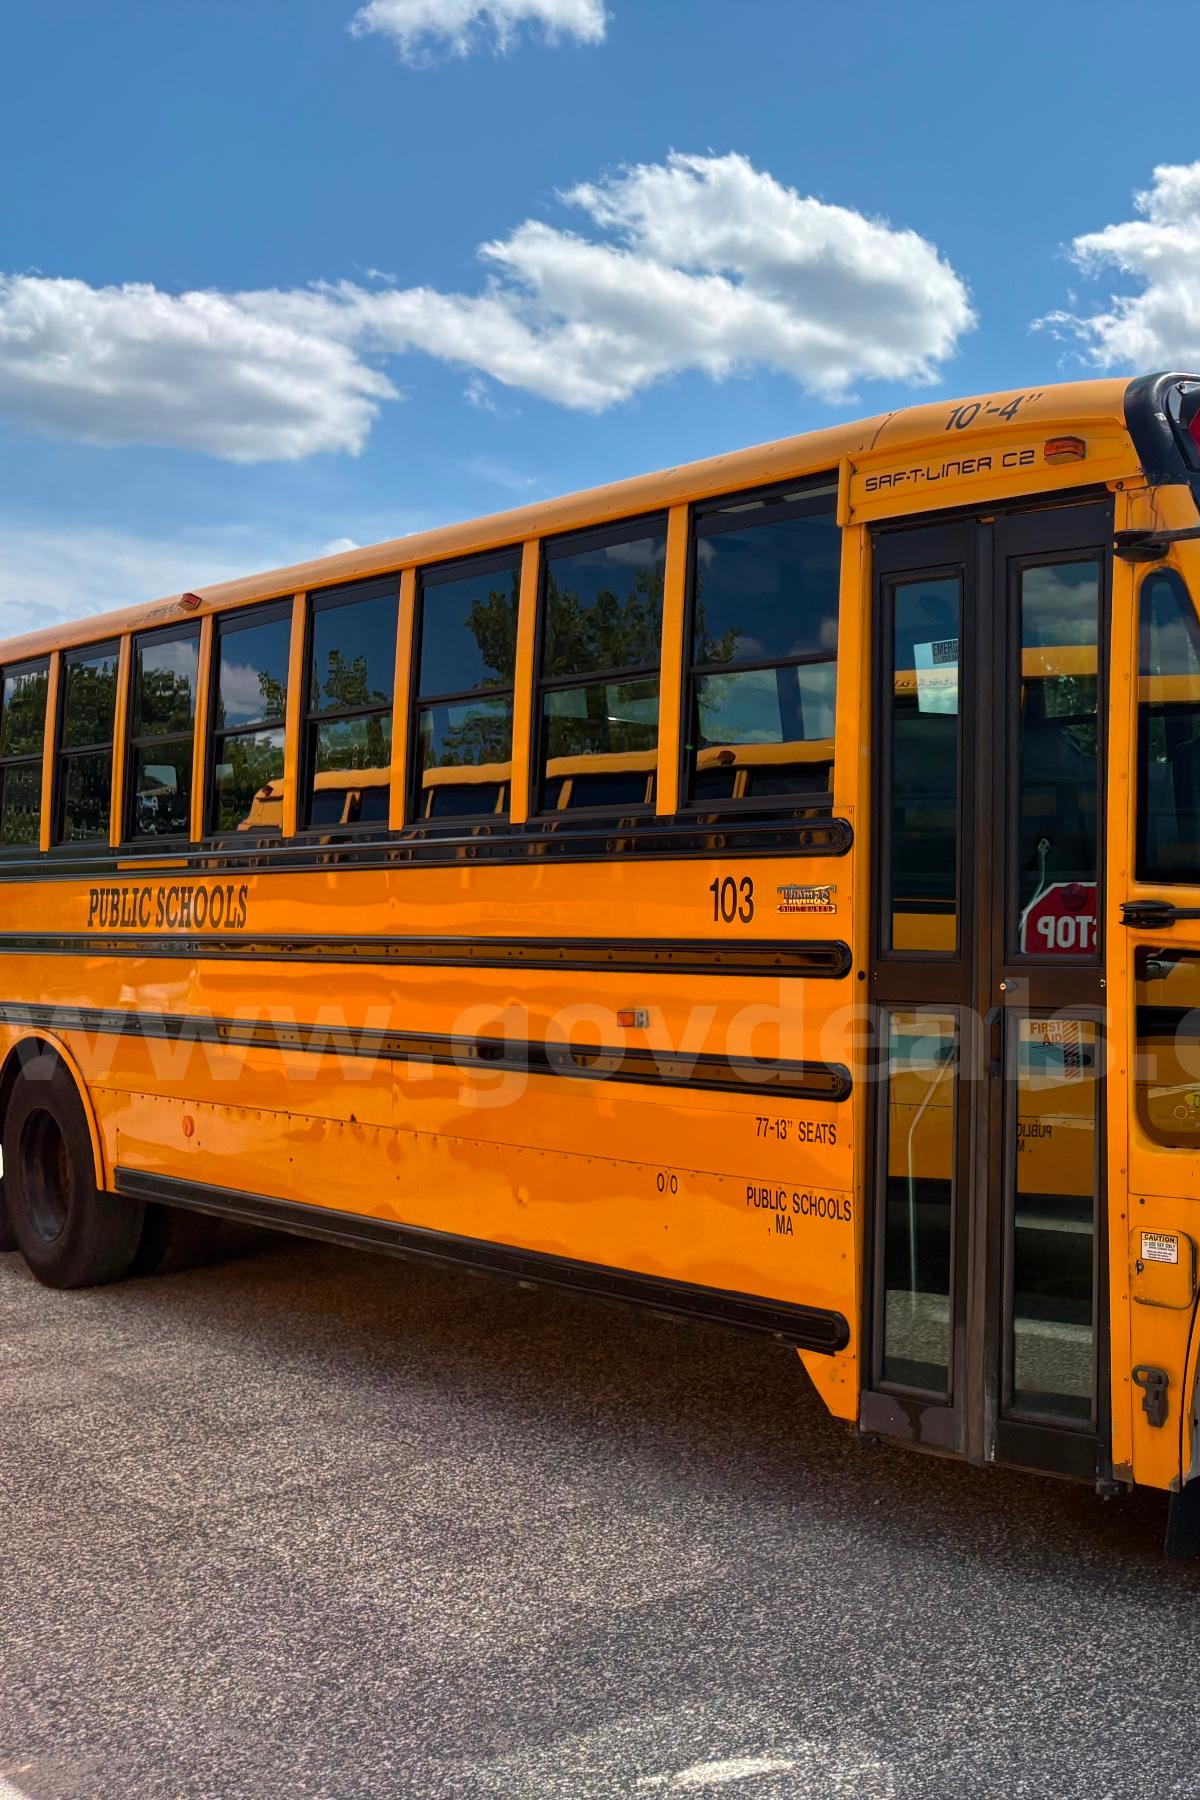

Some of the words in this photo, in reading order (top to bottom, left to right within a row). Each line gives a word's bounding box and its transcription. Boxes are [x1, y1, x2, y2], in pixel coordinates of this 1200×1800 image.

[865, 456, 992, 492] SAF-T-LINER
[1001, 450, 1034, 468] C2
[88, 887, 152, 928] PUBLIC
[155, 885, 248, 929] SCHOOLS
[709, 876, 754, 923] 103
[1030, 1021, 1062, 1034] FIRST
[1043, 1033, 1063, 1045] AID
[798, 1121, 837, 1145] SEATS
[746, 1186, 788, 1211] PUBLIC
[792, 1190, 852, 1222] SCHOOLS
[776, 1215, 794, 1236] MA
[1143, 1233, 1175, 1243] CAUTION
